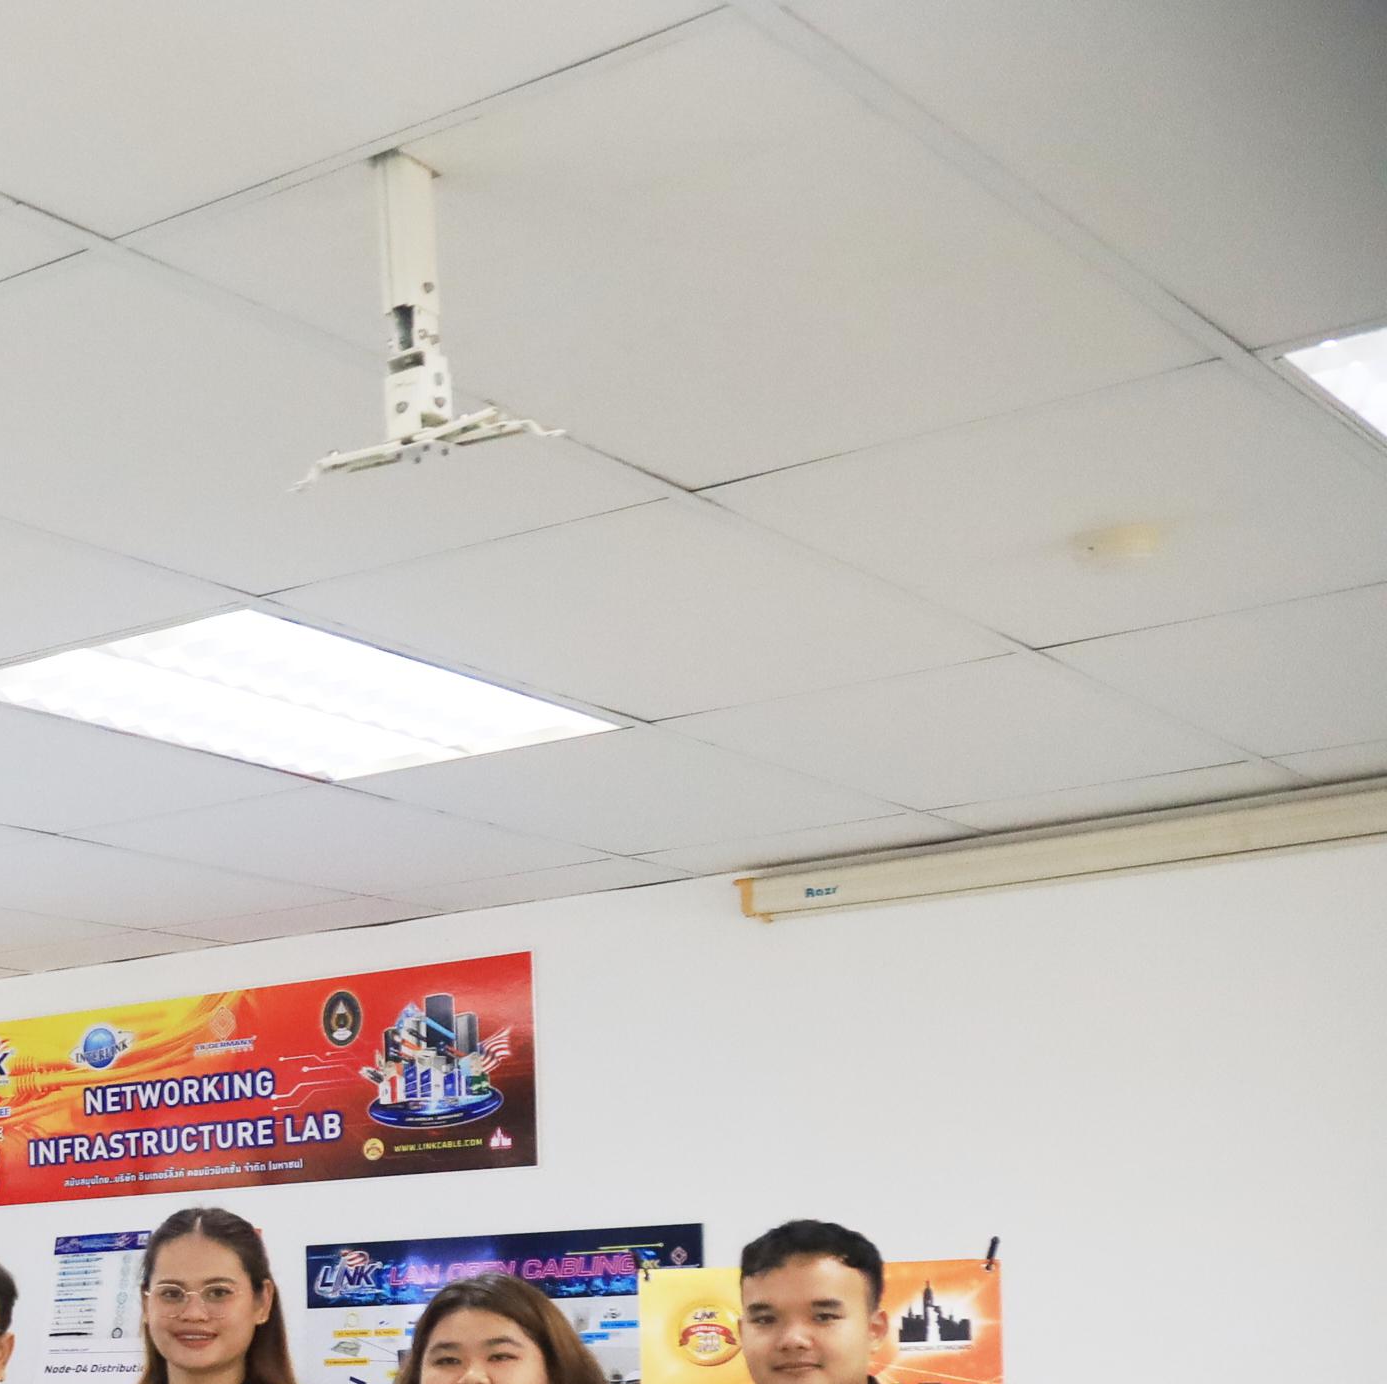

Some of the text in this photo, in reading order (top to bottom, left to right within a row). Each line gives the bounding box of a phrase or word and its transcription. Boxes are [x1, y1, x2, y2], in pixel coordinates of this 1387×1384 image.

[75, 1040, 129, 1064] INTERLINK
[84, 1070, 275, 1115] NETWORKING
[27, 1112, 342, 1167] INFRASTRUCTURE LAB
[393, 1138, 484, 1153] WWW.LINKCABLE.COM
[388, 1262, 440, 1286] LAN
[524, 1253, 634, 1279] CABLING
[44, 1364, 89, 1375] Node-04
